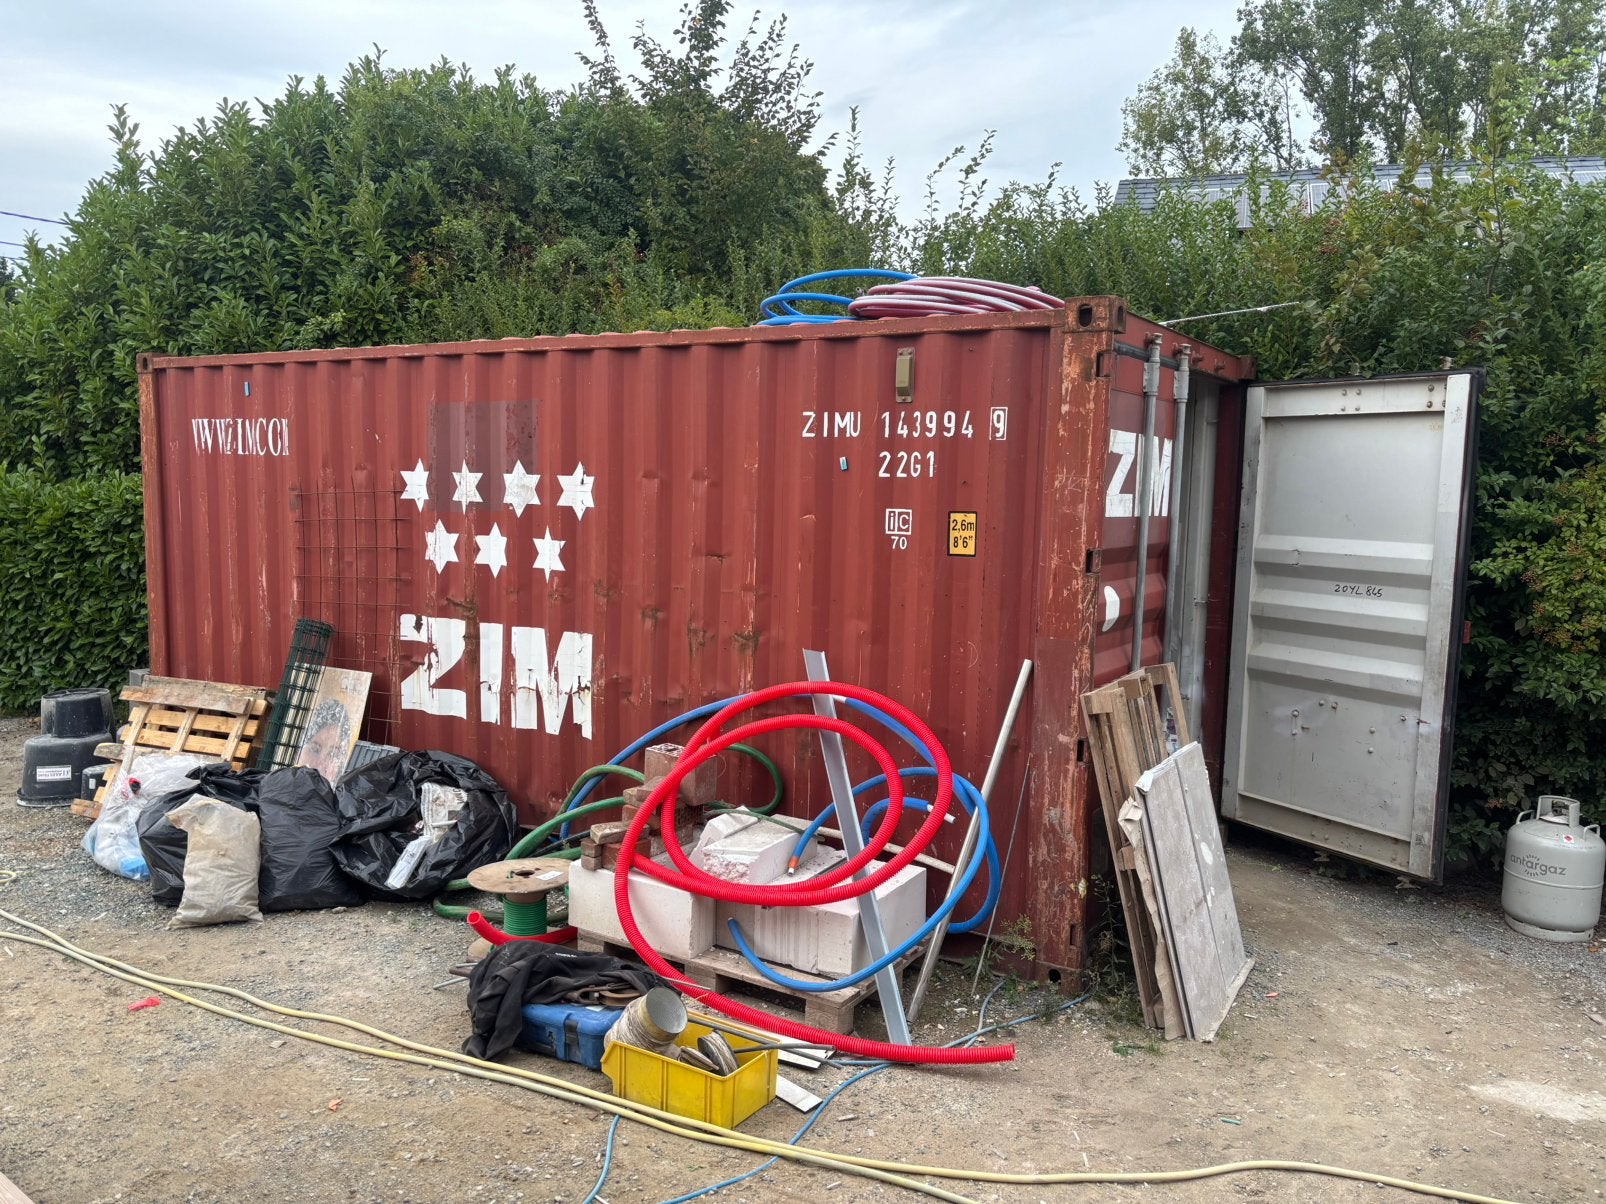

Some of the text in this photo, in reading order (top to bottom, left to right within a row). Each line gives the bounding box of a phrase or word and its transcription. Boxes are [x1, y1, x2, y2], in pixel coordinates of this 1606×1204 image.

[802, 410, 1006, 438] ZIMU 143994 9
[878, 451, 936, 478] 22G1
[951, 519, 975, 533] 2,6m
[891, 536, 908, 550] 70
[1334, 584, 1363, 595] 20YL
[400, 613, 593, 741] ZIM
[1510, 853, 1567, 876] antargaz
